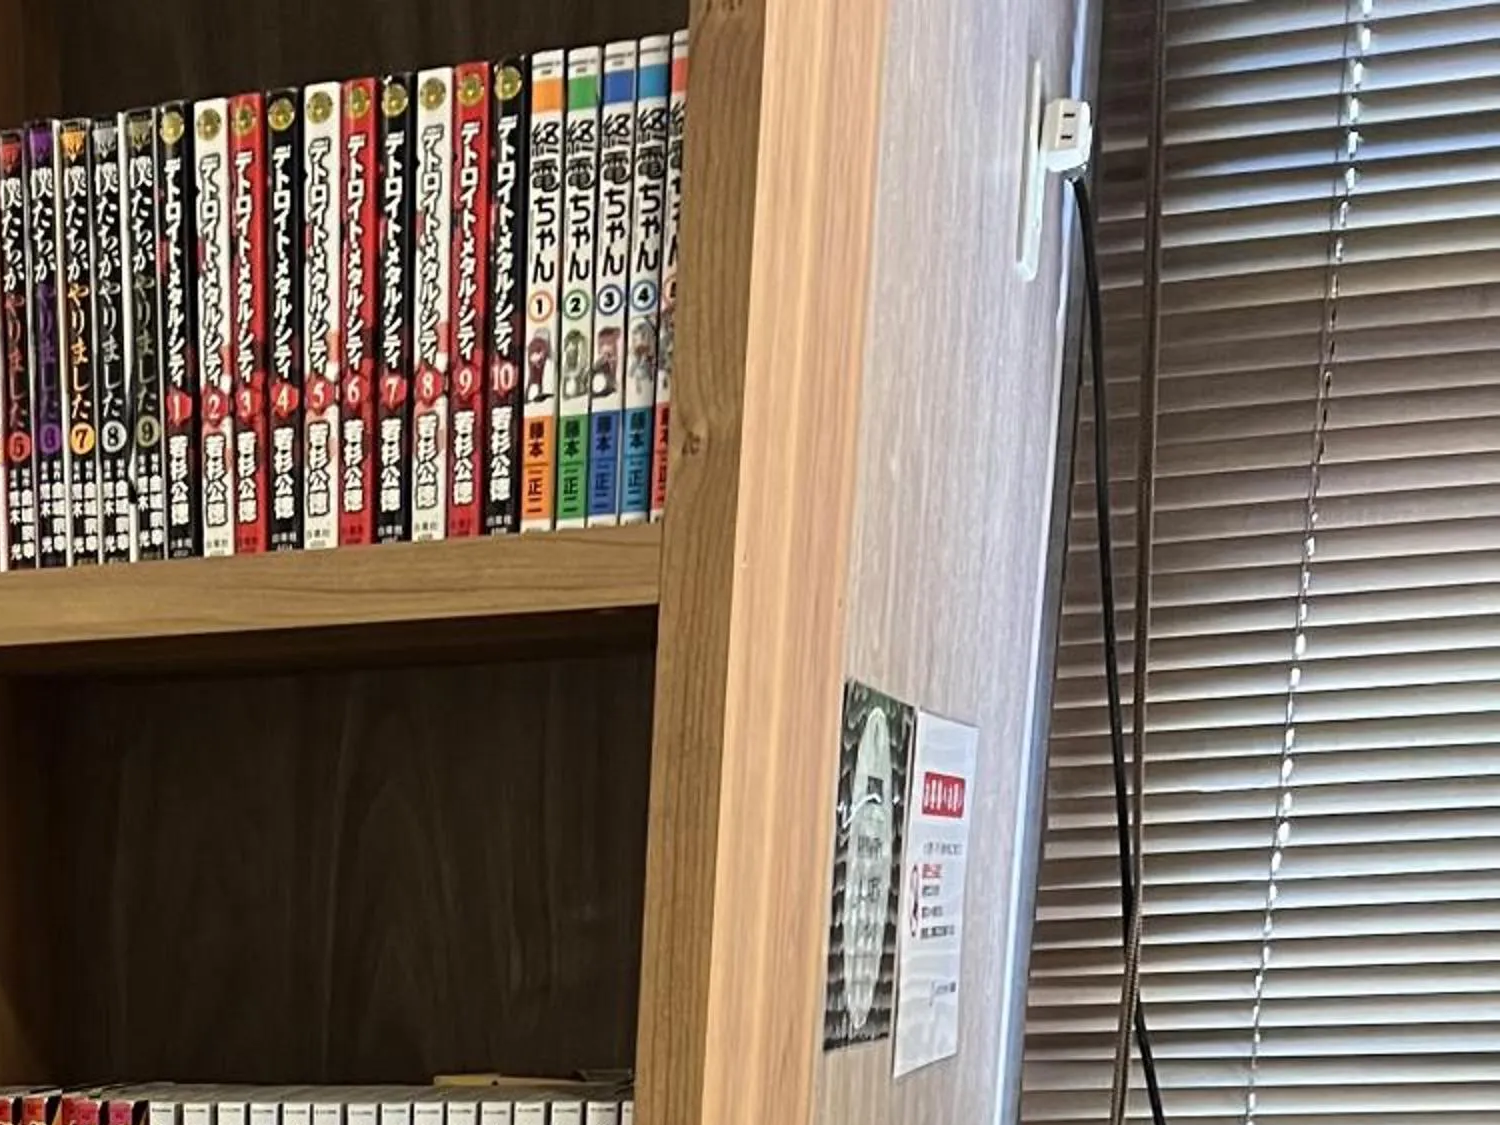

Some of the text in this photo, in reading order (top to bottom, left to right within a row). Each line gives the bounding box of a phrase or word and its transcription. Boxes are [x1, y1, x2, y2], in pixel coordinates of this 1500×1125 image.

[532, 121, 556, 283] 終電ちゃん
[565, 120, 595, 283] 終電ちゃん
[600, 117, 630, 280] 終電ちゃん
[634, 114, 666, 273] 終電ちゃん
[386, 379, 399, 400] 7
[422, 373, 434, 396] 8
[460, 372, 471, 394] 9
[493, 367, 513, 389] 10
[278, 388, 290, 412] 4
[313, 383, 325, 406] 5
[349, 382, 361, 402] 6
[174, 395, 183, 420] 1
[209, 399, 220, 420] 2
[242, 395, 252, 417] 3
